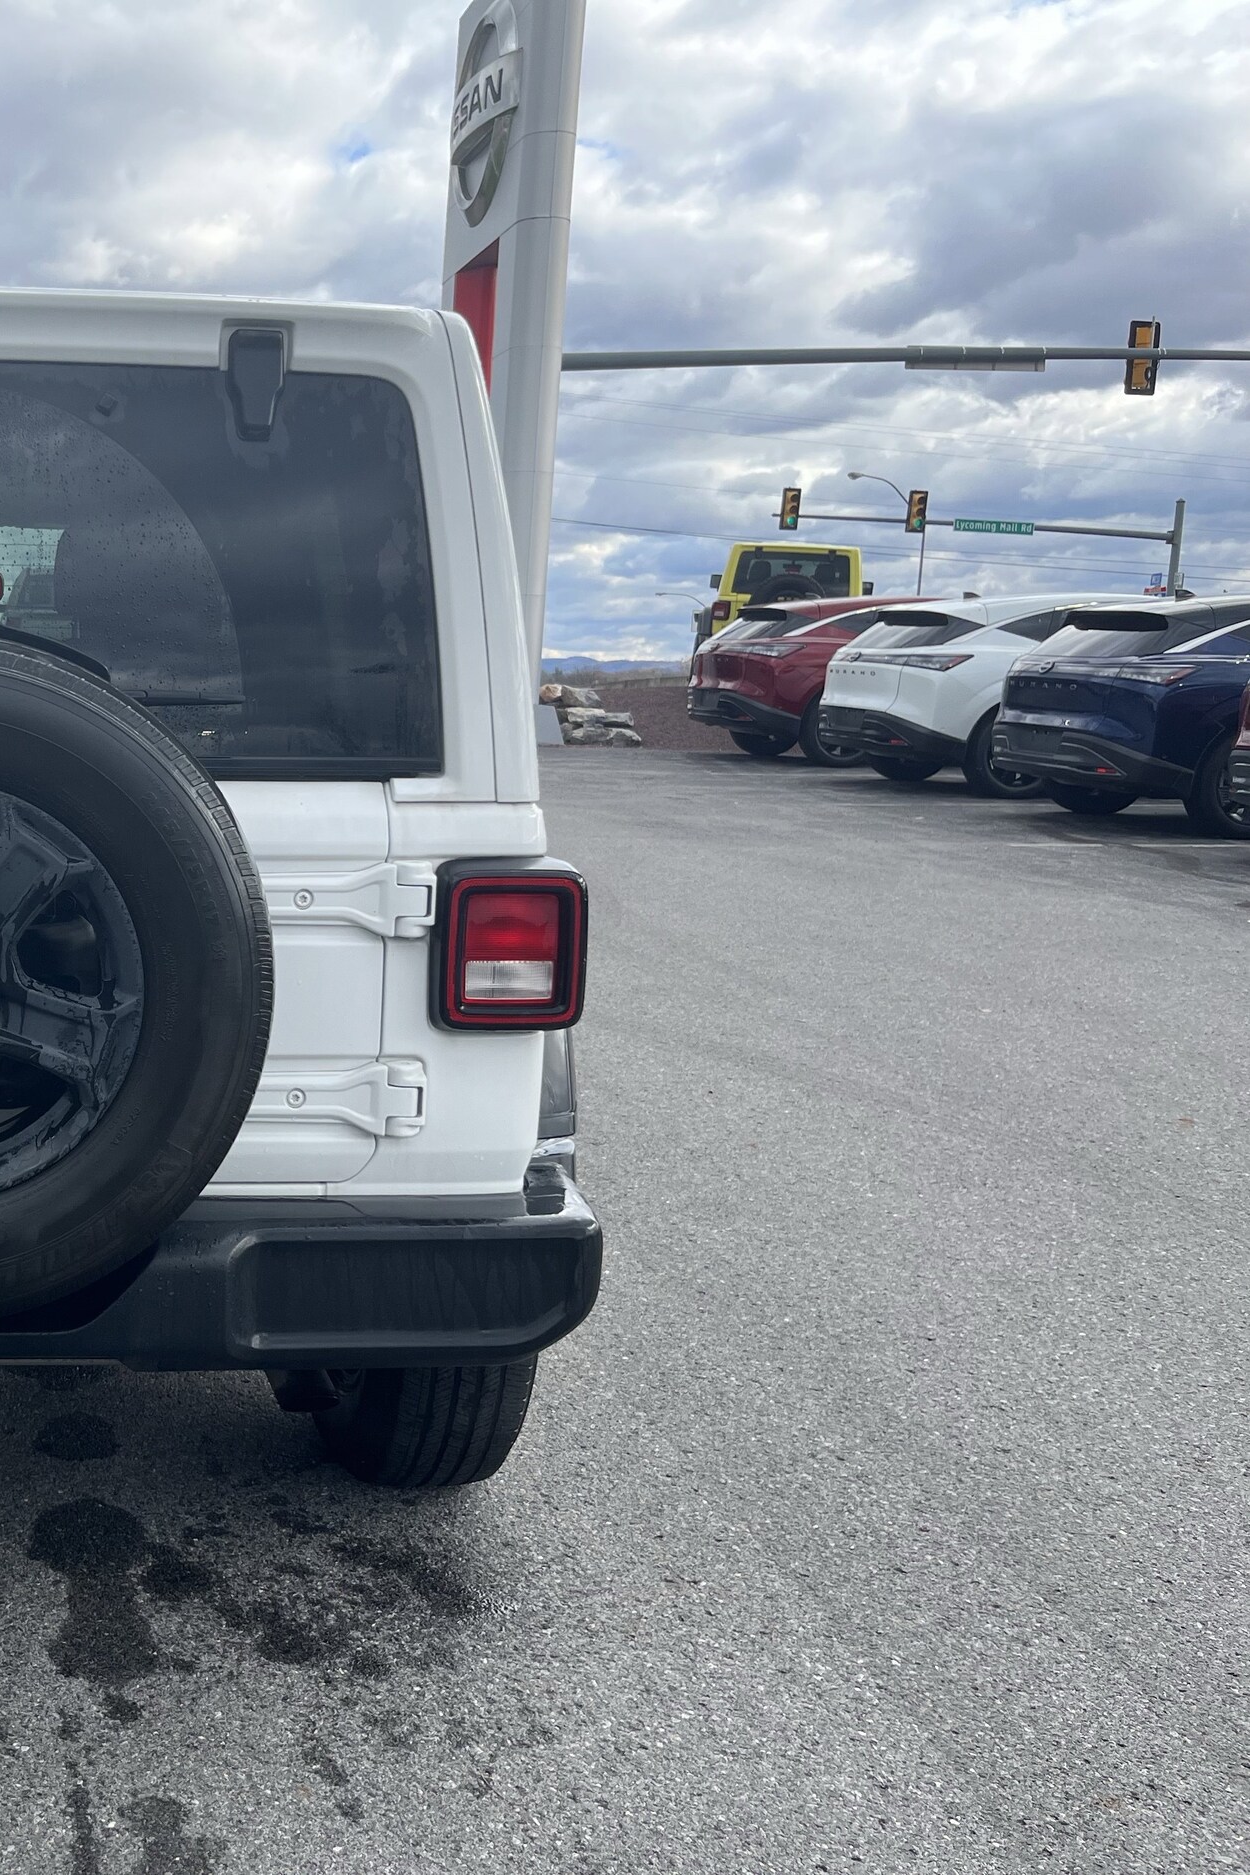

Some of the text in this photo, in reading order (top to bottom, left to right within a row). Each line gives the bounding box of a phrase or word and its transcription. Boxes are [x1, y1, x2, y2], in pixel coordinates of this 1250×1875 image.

[956, 520, 1033, 533] Lycoming Mall Rd
